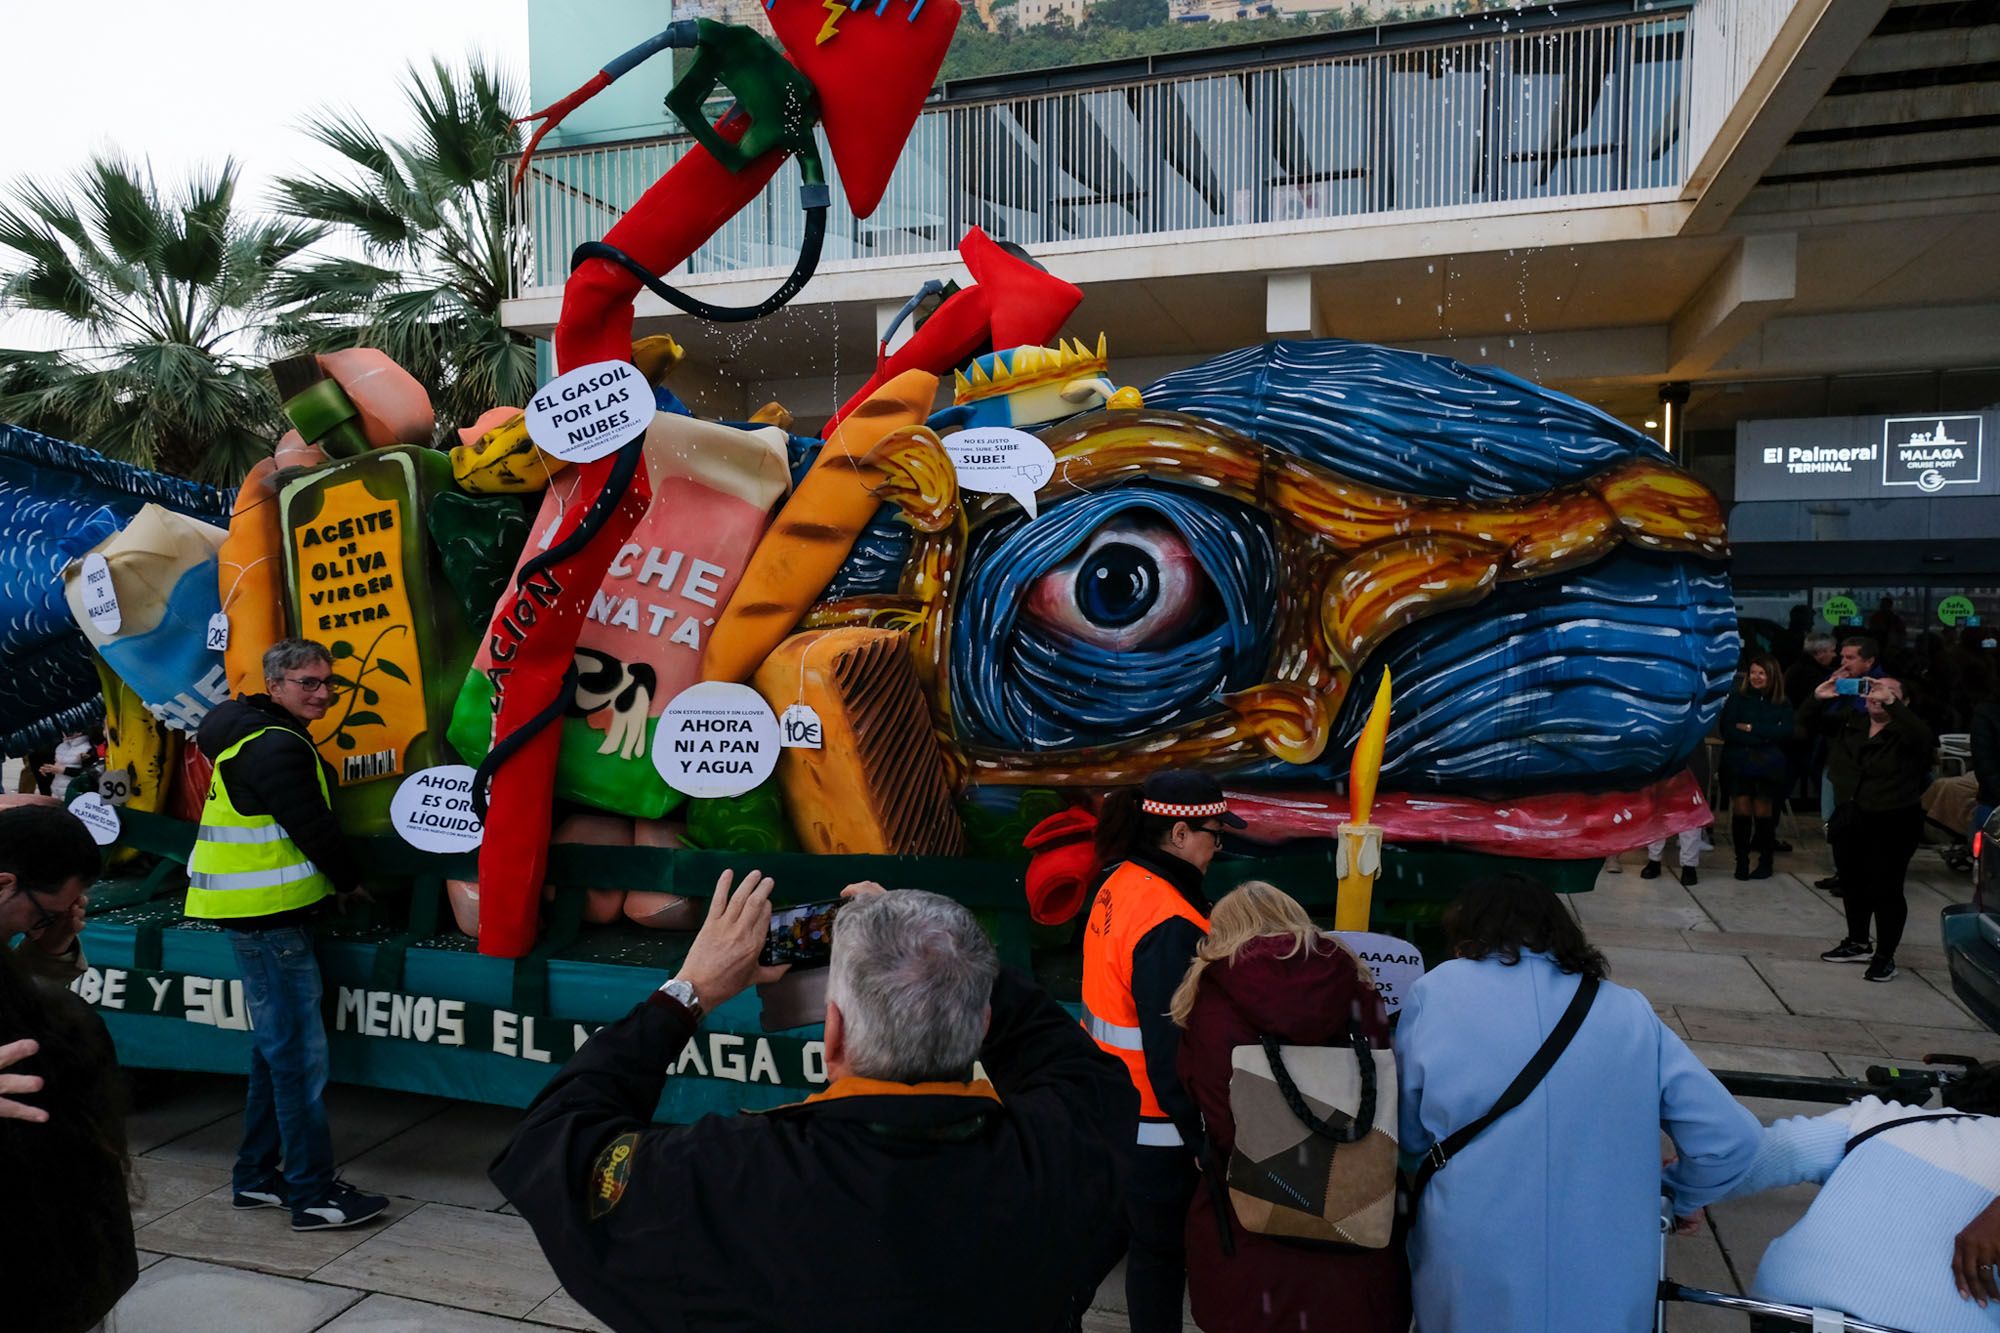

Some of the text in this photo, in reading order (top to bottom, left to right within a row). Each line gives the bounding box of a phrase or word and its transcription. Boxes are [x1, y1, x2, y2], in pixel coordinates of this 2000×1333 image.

[535, 366, 631, 412] EL GASOIL
[552, 388, 629, 428] POR LAS
[567, 410, 630, 445] NUBES
[1763, 444, 1964, 464] El Palmeral MALAGA
[1787, 463, 1852, 474] TERMINAL
[1907, 460, 1957, 469] CRUISE PORT
[303, 509, 394, 548] ACEITE
[338, 542, 357, 557] DE
[311, 551, 387, 581] OLIVA
[96, 587, 104, 598] DE
[309, 574, 393, 606] VIRGEN
[318, 603, 391, 630] EXTRA
[208, 628, 227, 648] 20€
[680, 719, 753, 732] AHORA
[786, 719, 822, 744] 10€
[675, 740, 759, 753] NI A PAN
[680, 761, 753, 774] Y AGUA
[102, 781, 127, 799] 30
[421, 794, 442, 808] ES
[409, 810, 482, 833] LÍQUIDO
[1359, 952, 1420, 966] AAAAR
[70, 967, 128, 1009] BE
[147, 976, 172, 1012] Y
[183, 975, 253, 1031] SU
[336, 986, 465, 1045] MENOS
[493, 1009, 551, 1063] EL
